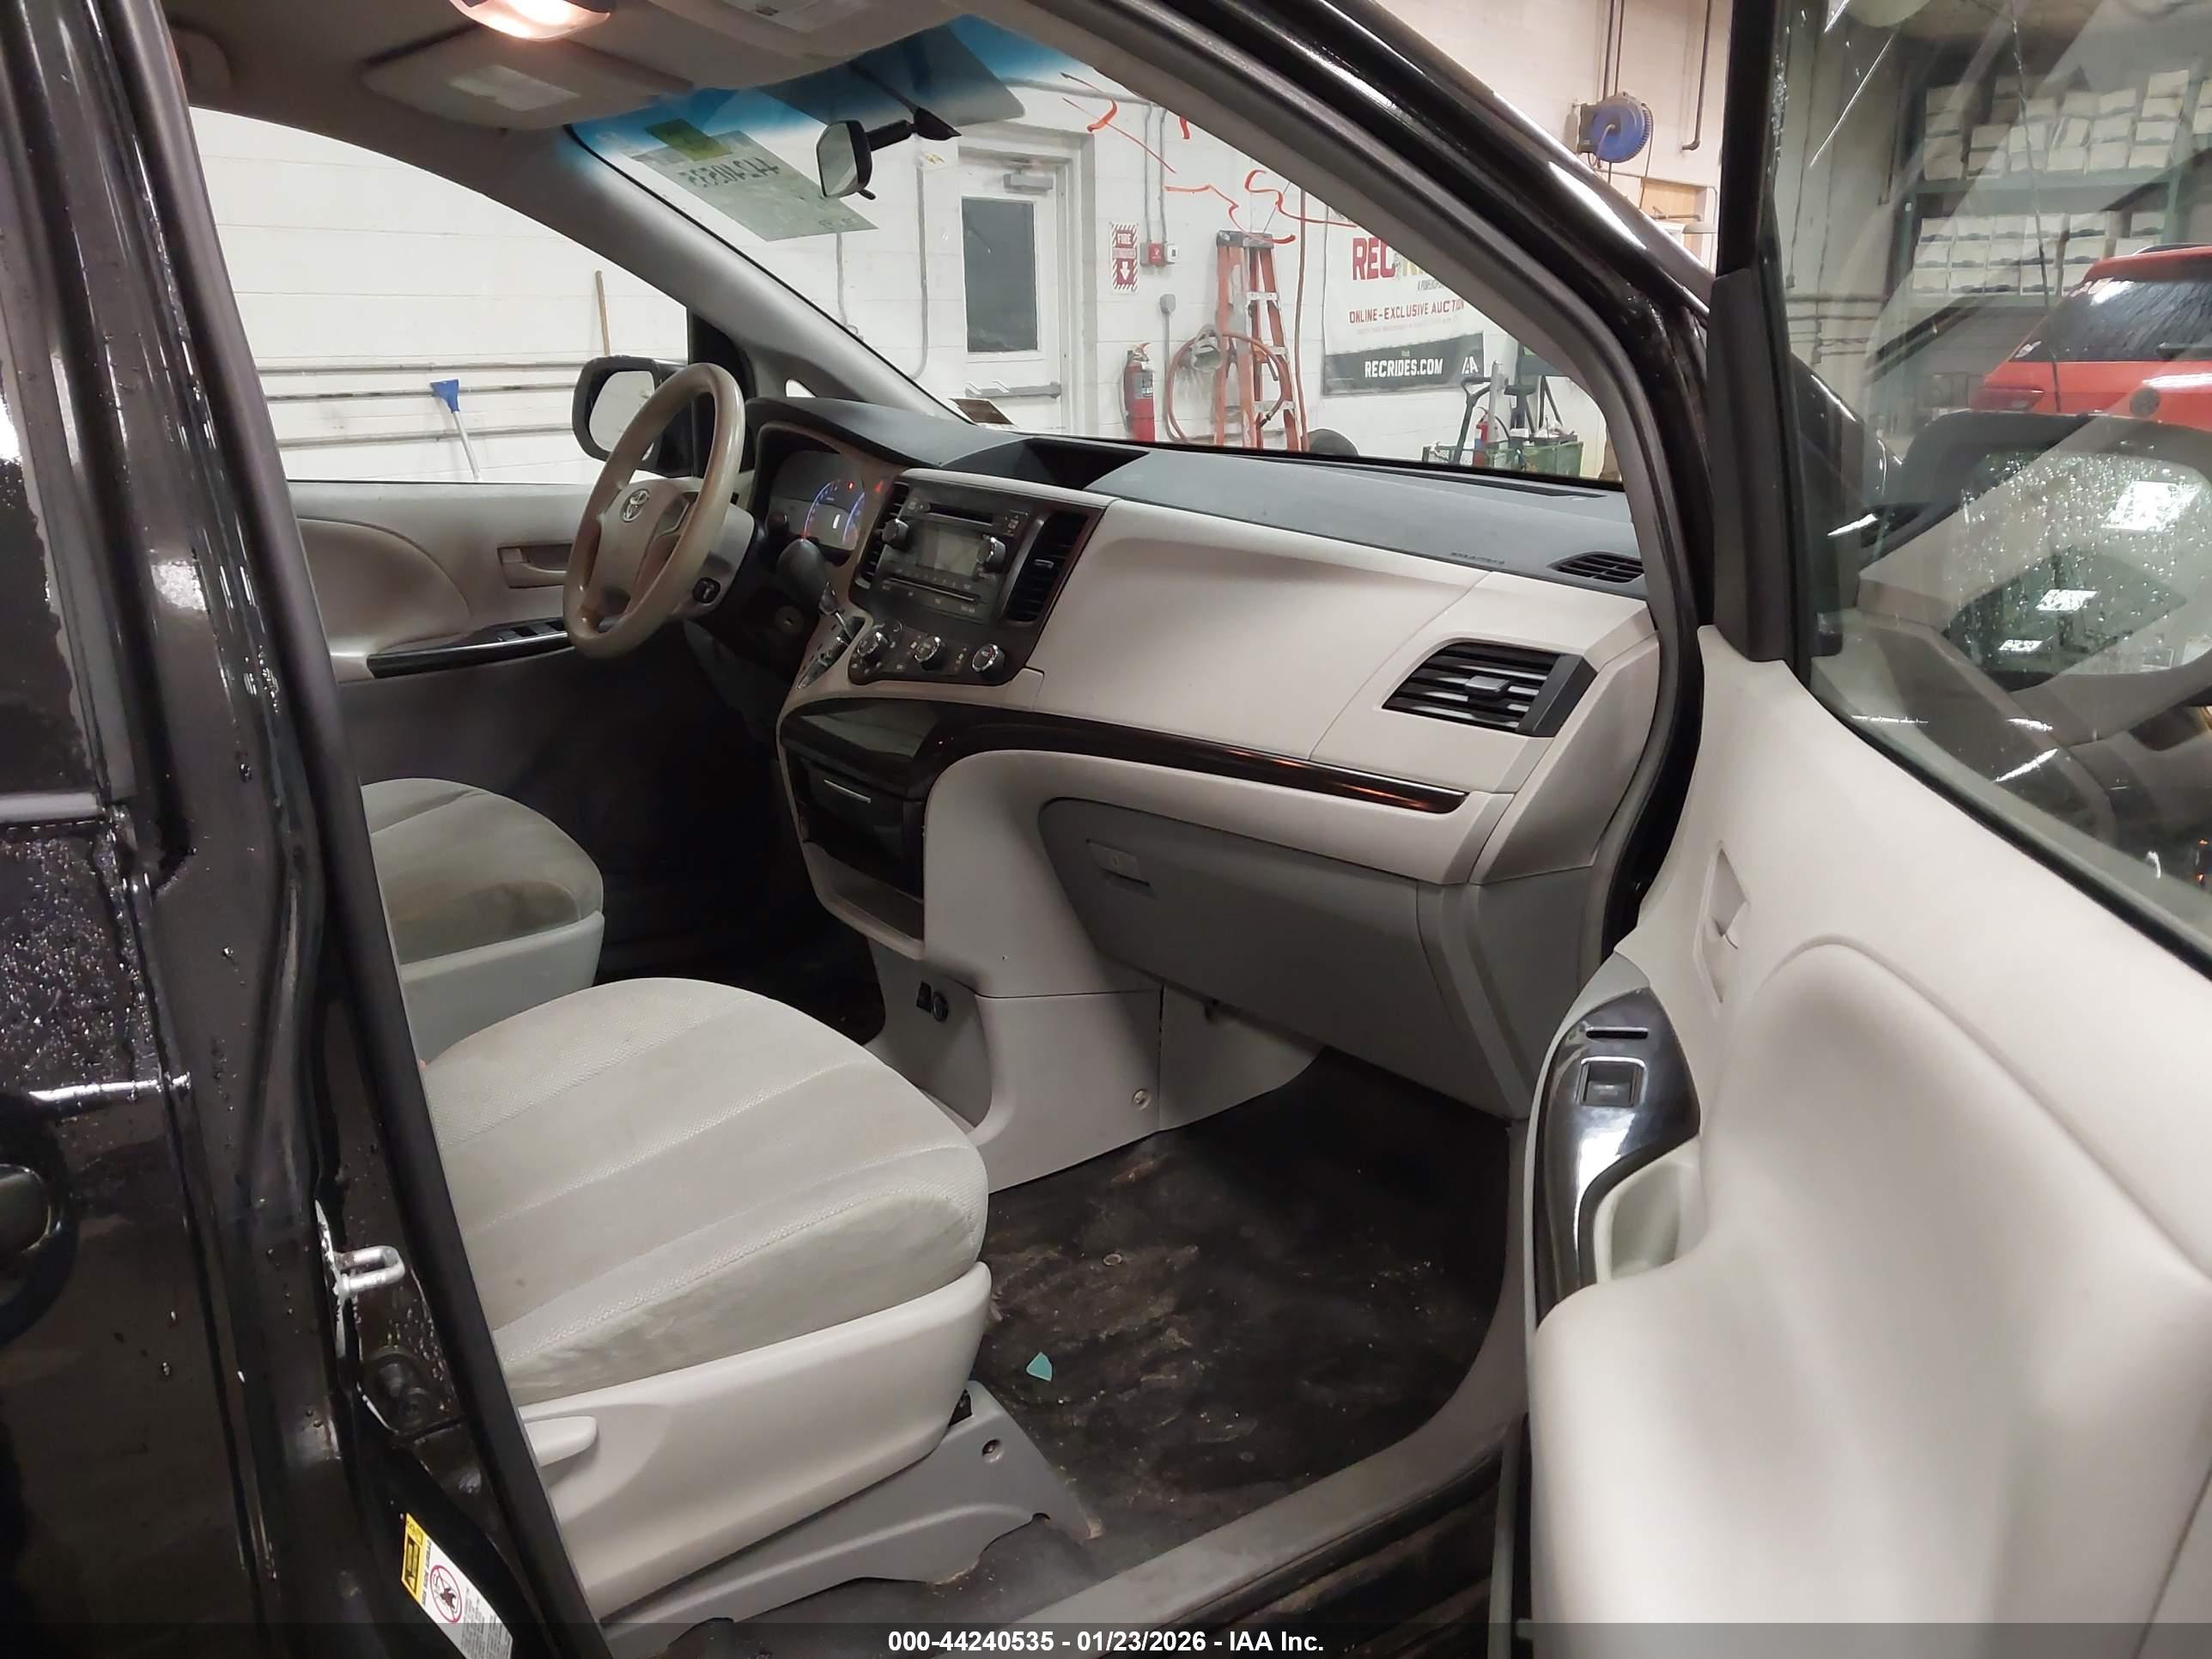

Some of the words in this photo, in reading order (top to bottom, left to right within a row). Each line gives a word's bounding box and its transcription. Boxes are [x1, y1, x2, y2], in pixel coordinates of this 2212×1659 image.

[1117, 234, 1132, 244] FIRE
[1349, 303, 1429, 324] ONLINE-EXCLUSIVE
[1364, 357, 1443, 378] RECRIDES.COM
